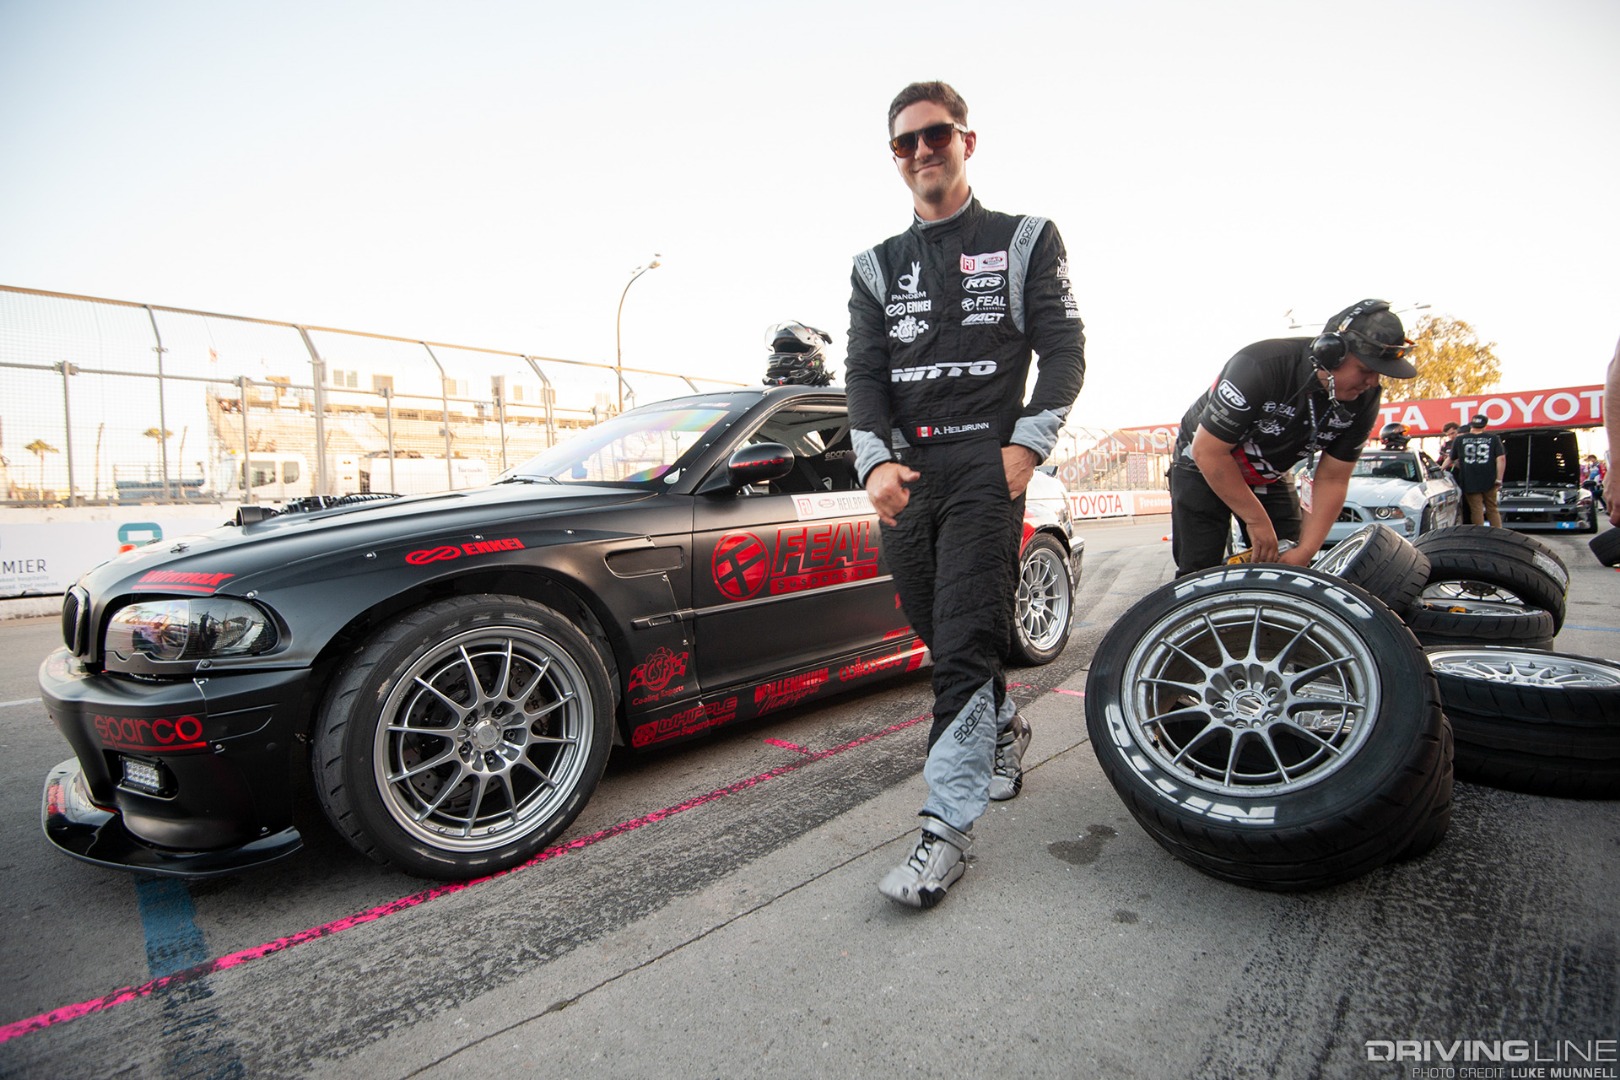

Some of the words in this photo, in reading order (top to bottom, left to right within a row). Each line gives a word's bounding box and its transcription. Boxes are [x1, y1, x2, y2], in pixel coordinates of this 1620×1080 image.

[966, 277, 1001, 289] RTS
[891, 291, 927, 302] PANDEM
[907, 300, 932, 313] ENKEI
[976, 296, 1006, 306] FEAL
[891, 360, 997, 382] NITTO
[1220, 382, 1247, 407] RTS
[933, 427, 943, 435] A.
[943, 422, 990, 434] HEILBRUNN
[1464, 443, 1490, 464] 99
[1070, 494, 1123, 516] TOYOTA
[461, 537, 526, 556] ENKEI
[771, 520, 879, 577] FEAL
[3, 559, 47, 574] MIER
[777, 568, 874, 590] Suspension
[754, 667, 830, 703] MILLENNIUM
[658, 696, 738, 733] WHIPPLE
[953, 696, 987, 744] sparco
[95, 715, 203, 749] sparco
